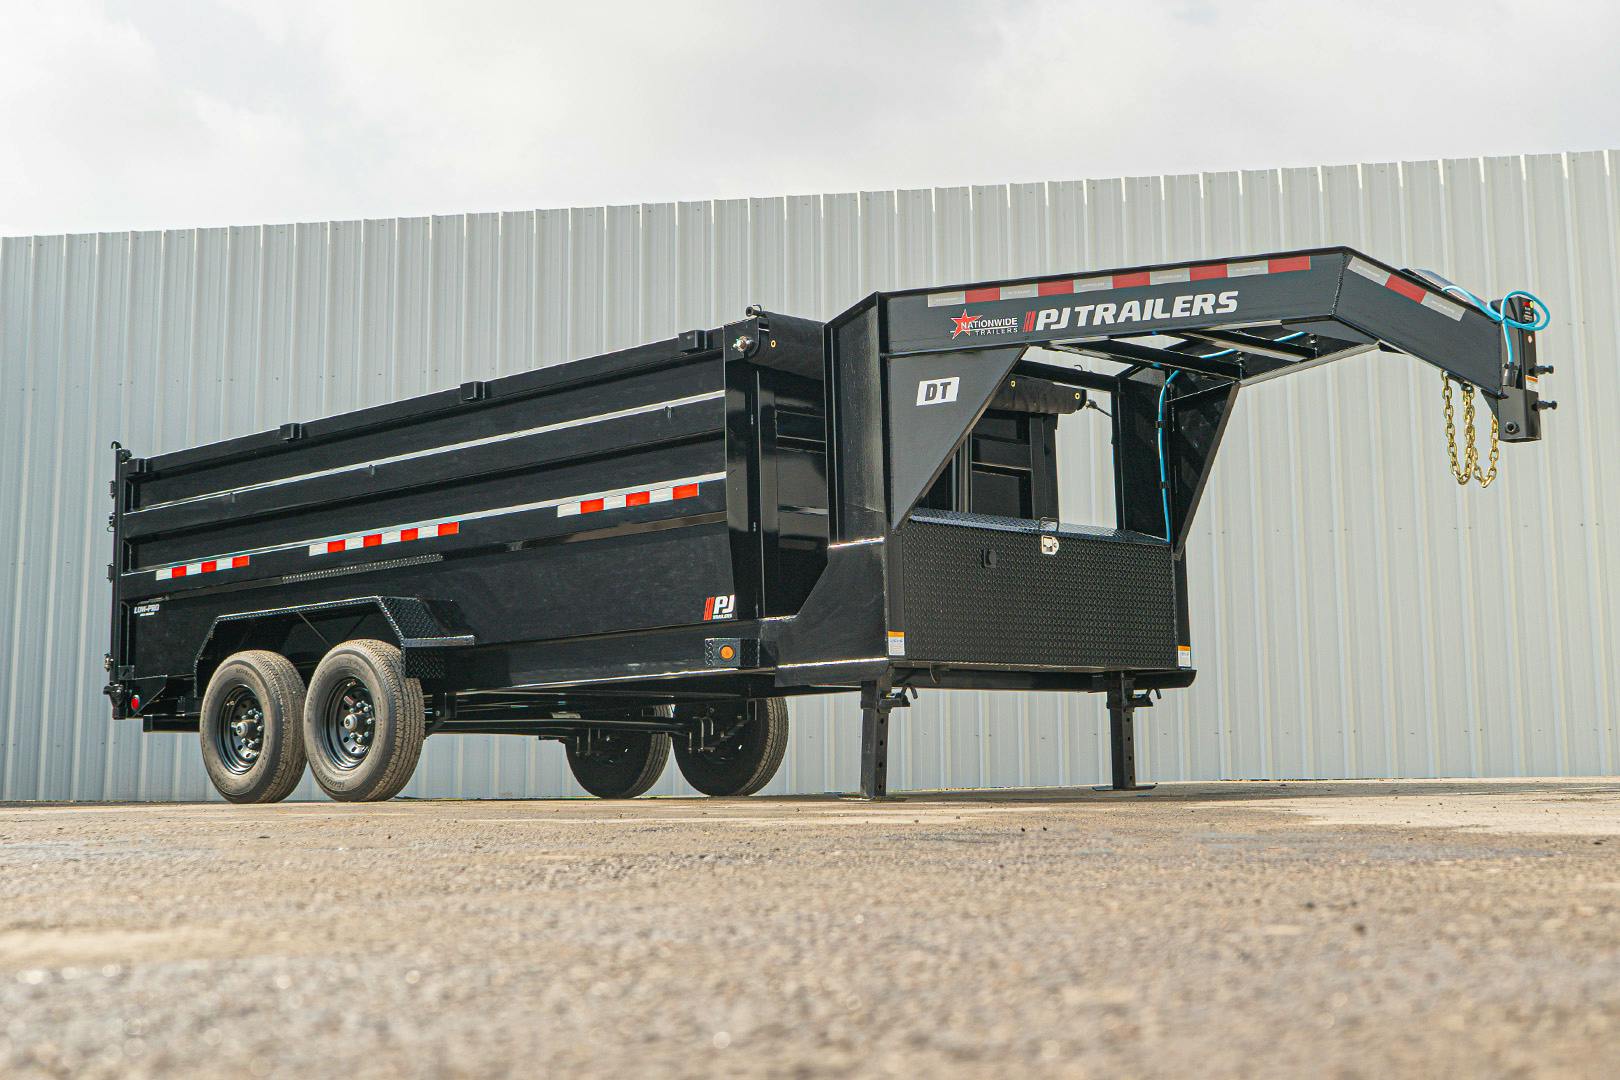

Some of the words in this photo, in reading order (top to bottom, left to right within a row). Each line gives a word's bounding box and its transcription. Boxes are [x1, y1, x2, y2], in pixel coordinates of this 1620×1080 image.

[1035, 307, 1071, 331] PJ
[1074, 290, 1239, 327] TRAILERS
[960, 317, 1018, 329] NATIONWIDE
[975, 328, 1018, 337] TRAILERS
[924, 381, 952, 402] DT
[713, 594, 735, 614] PJ
